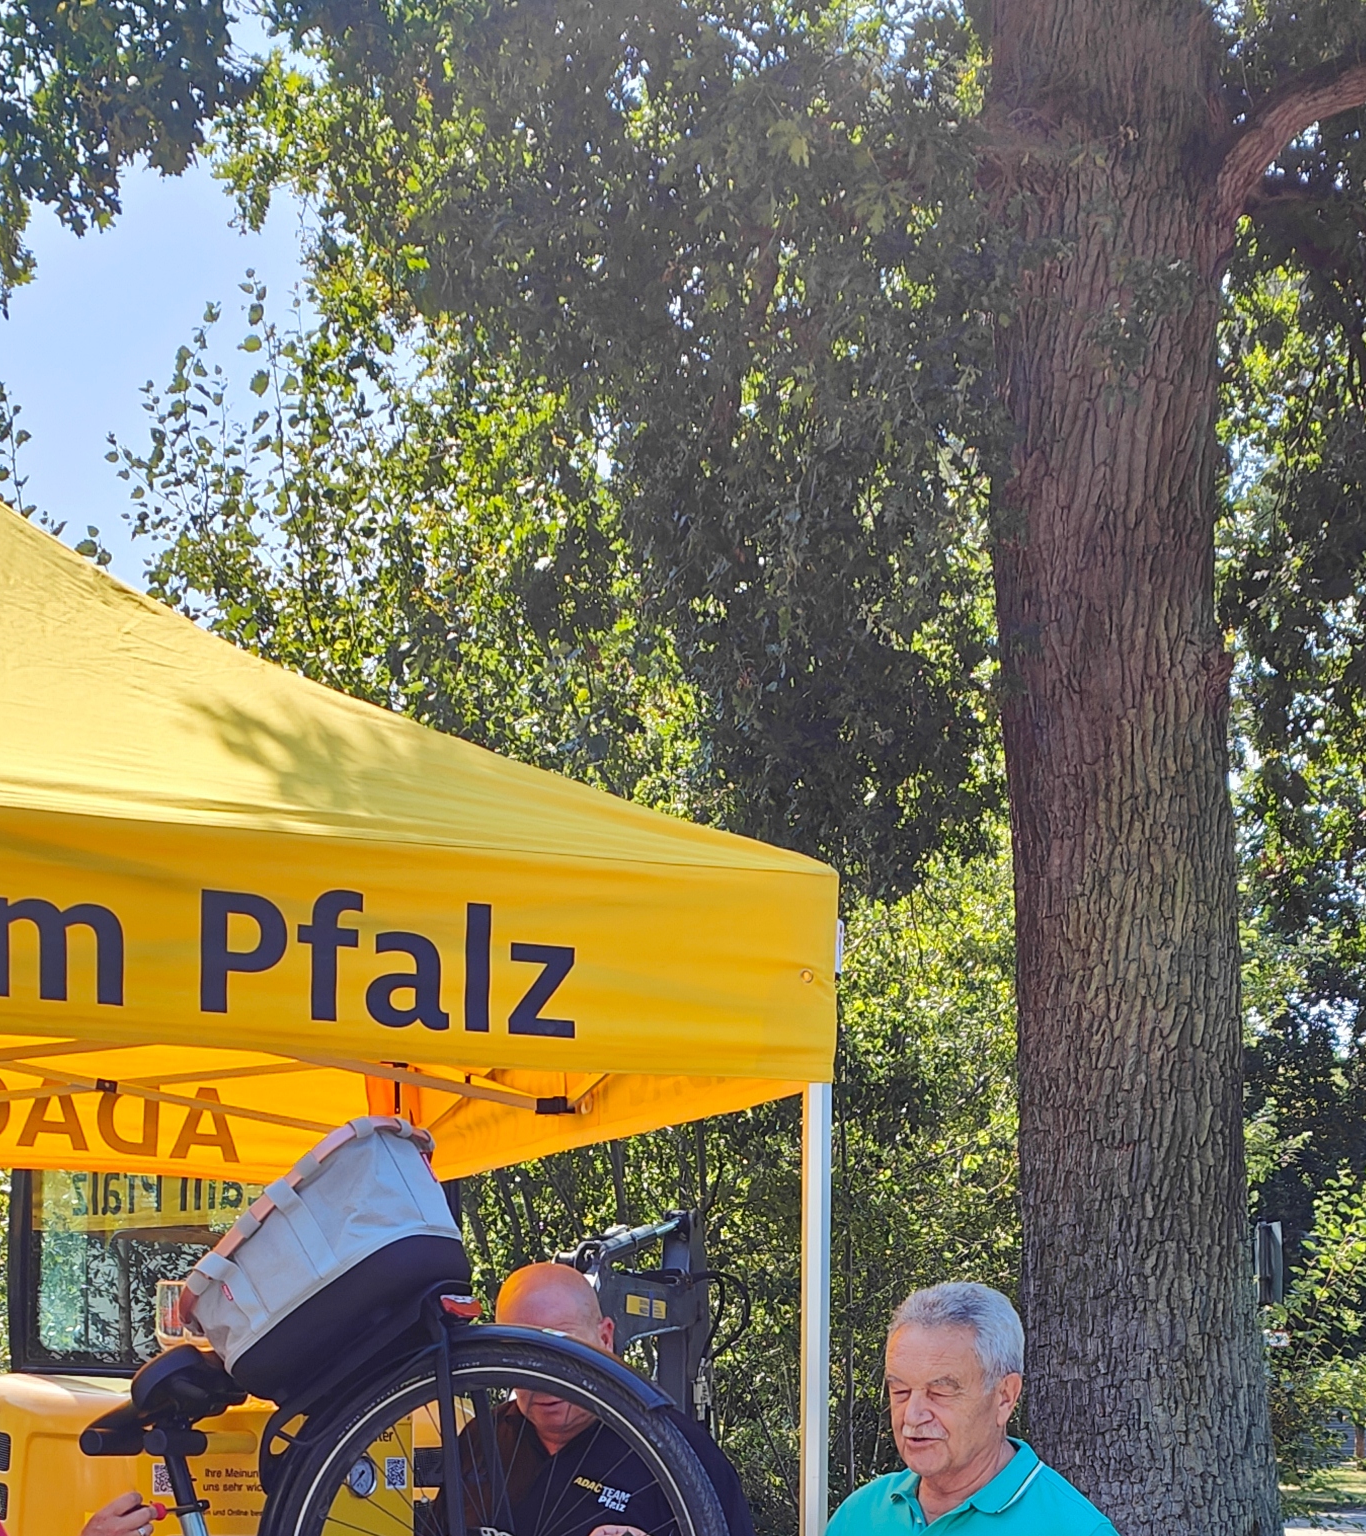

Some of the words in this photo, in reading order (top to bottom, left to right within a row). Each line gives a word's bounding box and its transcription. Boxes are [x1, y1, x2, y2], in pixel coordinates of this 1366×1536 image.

[200, 888, 578, 1039] Pfalz
[205, 1468, 222, 1478] Ihre
[225, 1467, 259, 1478] Meinun
[203, 1483, 220, 1491] uns
[223, 1482, 243, 1491] sehr
[573, 1476, 603, 1493] ADAC
[601, 1486, 632, 1503] TEAM
